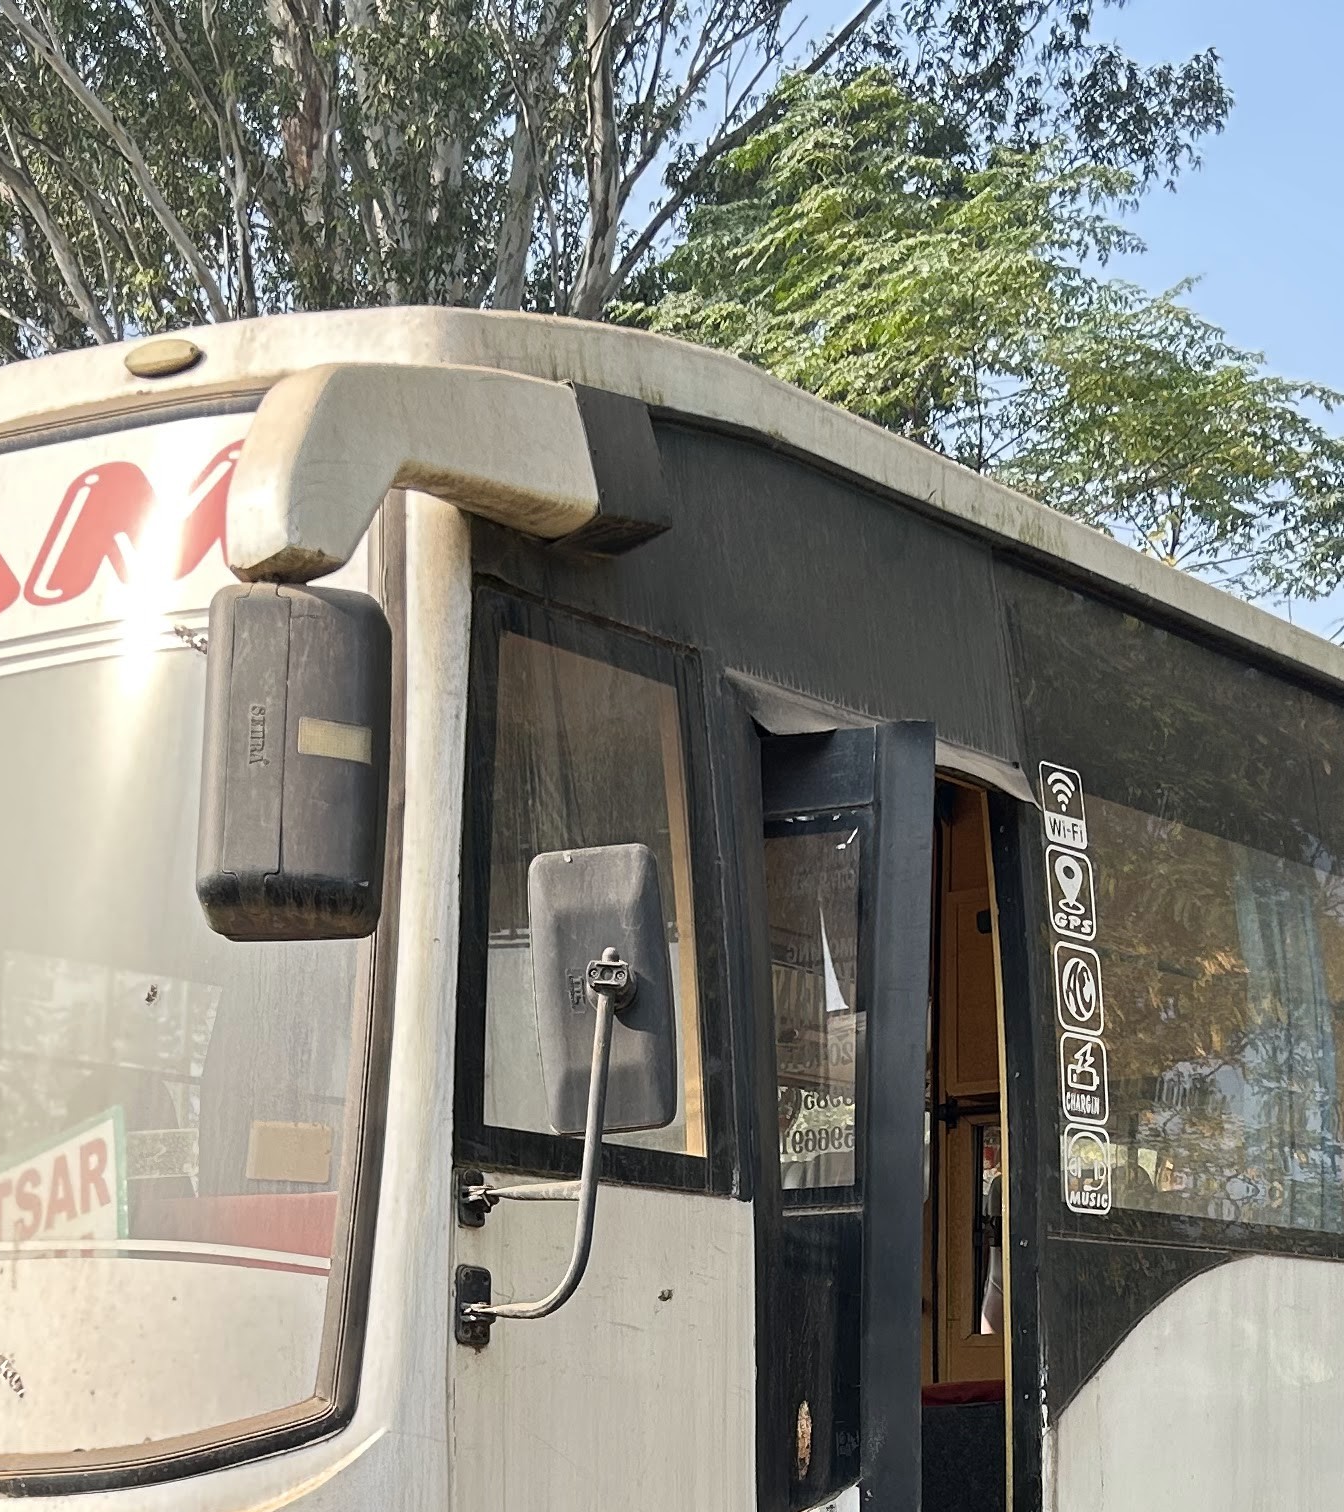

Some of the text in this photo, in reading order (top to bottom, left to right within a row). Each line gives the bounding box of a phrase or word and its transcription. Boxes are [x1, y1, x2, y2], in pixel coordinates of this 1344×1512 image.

[1048, 815, 1084, 843] Wi-Fi
[1054, 912, 1093, 934] GPS
[1069, 1190, 1109, 1209] MUSIC
